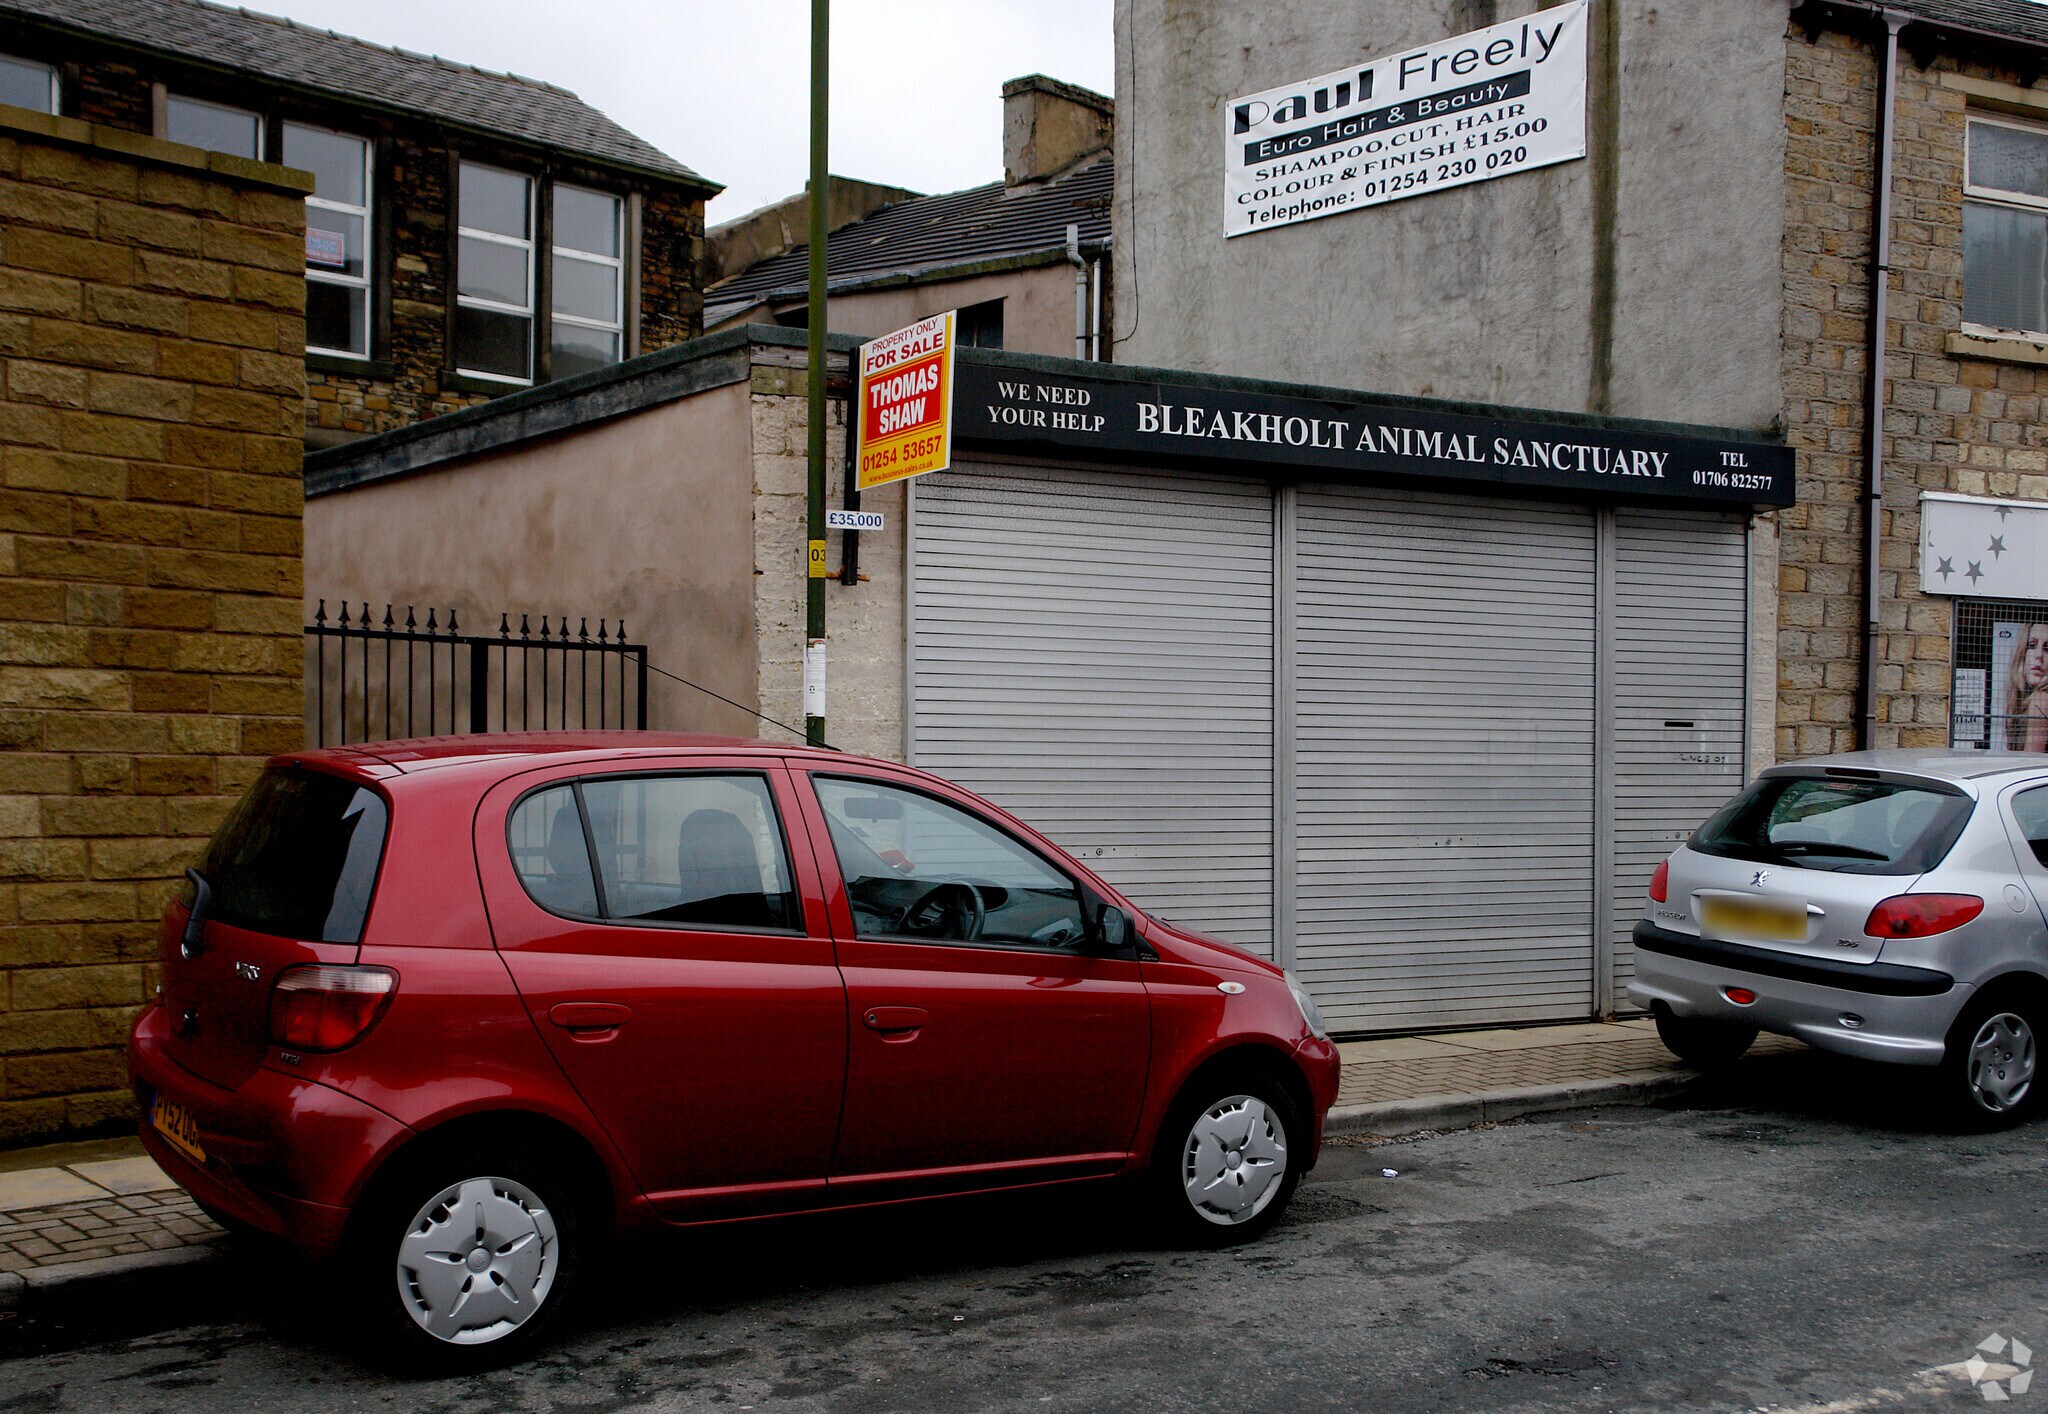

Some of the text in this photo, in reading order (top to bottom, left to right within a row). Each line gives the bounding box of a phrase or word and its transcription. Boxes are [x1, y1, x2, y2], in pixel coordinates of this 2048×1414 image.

[1234, 22, 1564, 135] Paul Freely
[1259, 83, 1509, 158] Euro Hair & Beauty
[1455, 103, 1526, 132] HAIR
[1237, 117, 1548, 204] COLOUR & FINISH £15.00
[1247, 146, 1527, 225] Telephone: 01254 230 020
[866, 331, 944, 372] FOR SALE
[872, 318, 938, 354] PROPERTY ONLY
[870, 363, 939, 409] THOMAS
[997, 381, 1091, 406] WE NEED
[879, 397, 927, 434] SHAW
[987, 405, 1105, 432] YOUR HELP
[863, 434, 942, 472] 01254 53657
[1136, 402, 1669, 478] BLEAKHOLT ANIMAL SANCTUARY
[869, 460, 933, 482] www.business-sales.co.uk
[1720, 451, 1748, 468] TEL
[1692, 470, 1773, 491] 01706 822577
[829, 512, 882, 528] £35,000
